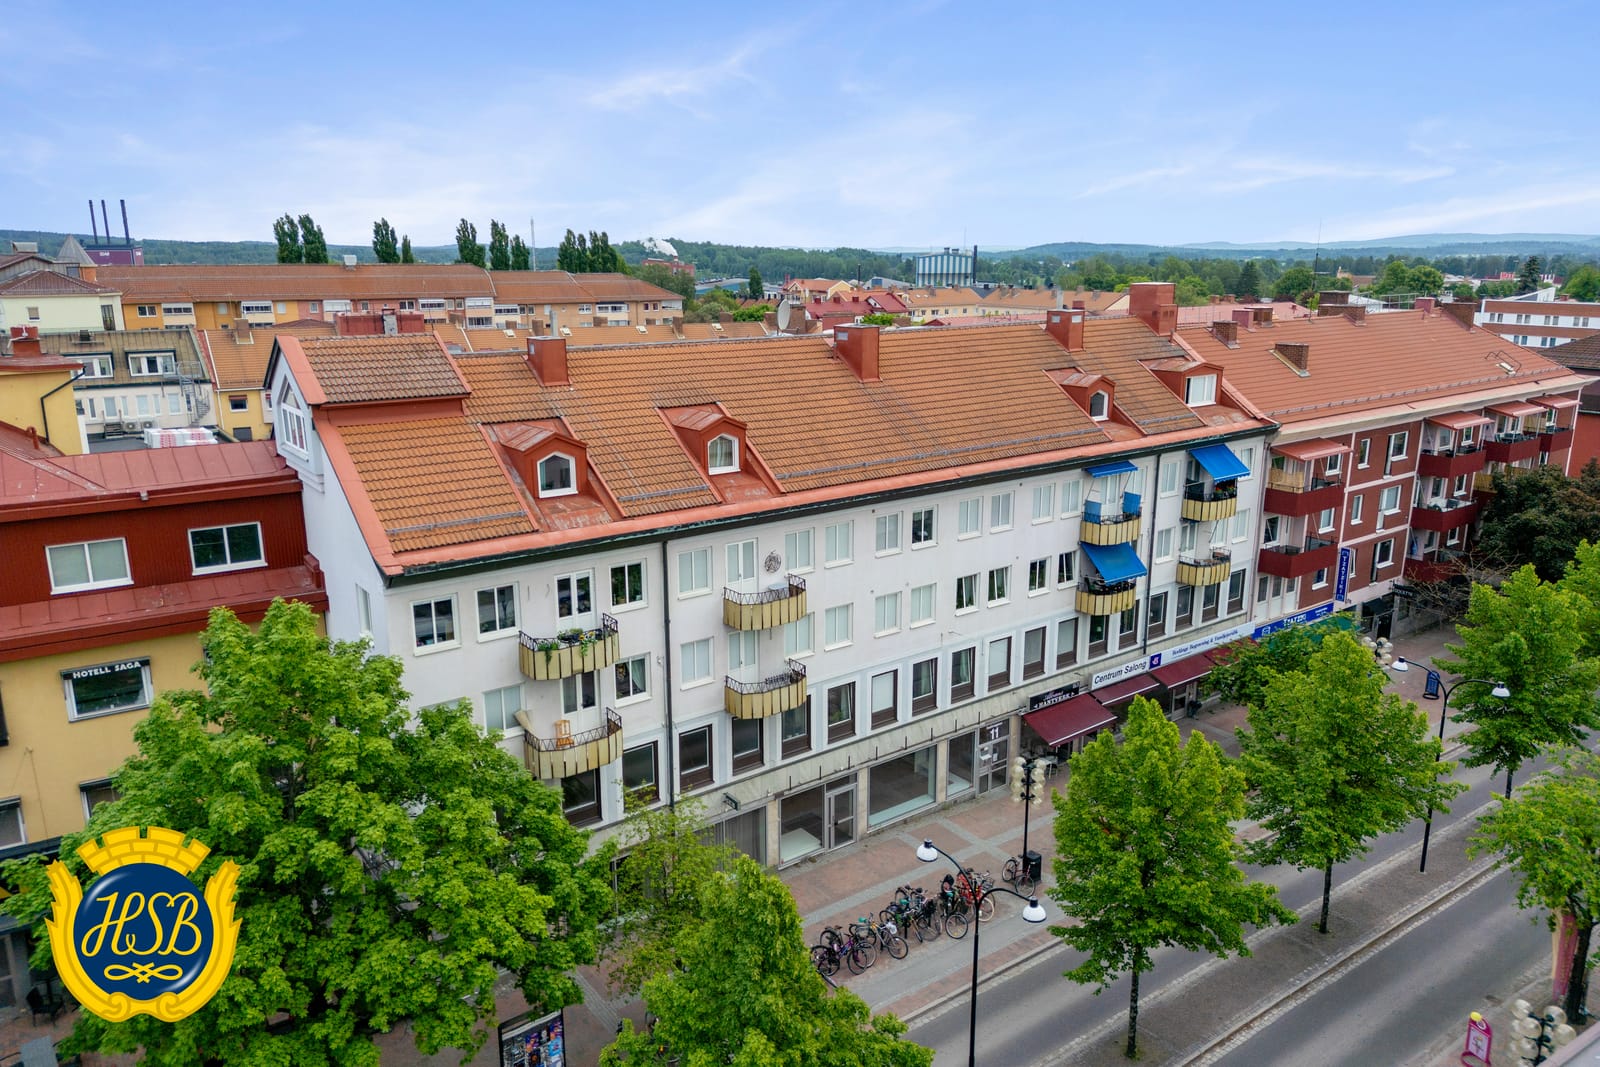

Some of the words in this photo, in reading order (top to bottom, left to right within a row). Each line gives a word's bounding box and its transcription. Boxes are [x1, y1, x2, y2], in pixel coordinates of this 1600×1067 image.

[1338, 556, 1348, 593] TZATZIKI
[73, 666, 111, 679] HOTELL
[115, 661, 142, 672] SAGA
[1094, 669, 1123, 684] Centrum
[1124, 661, 1147, 674] Salong
[990, 727, 999, 740] 11
